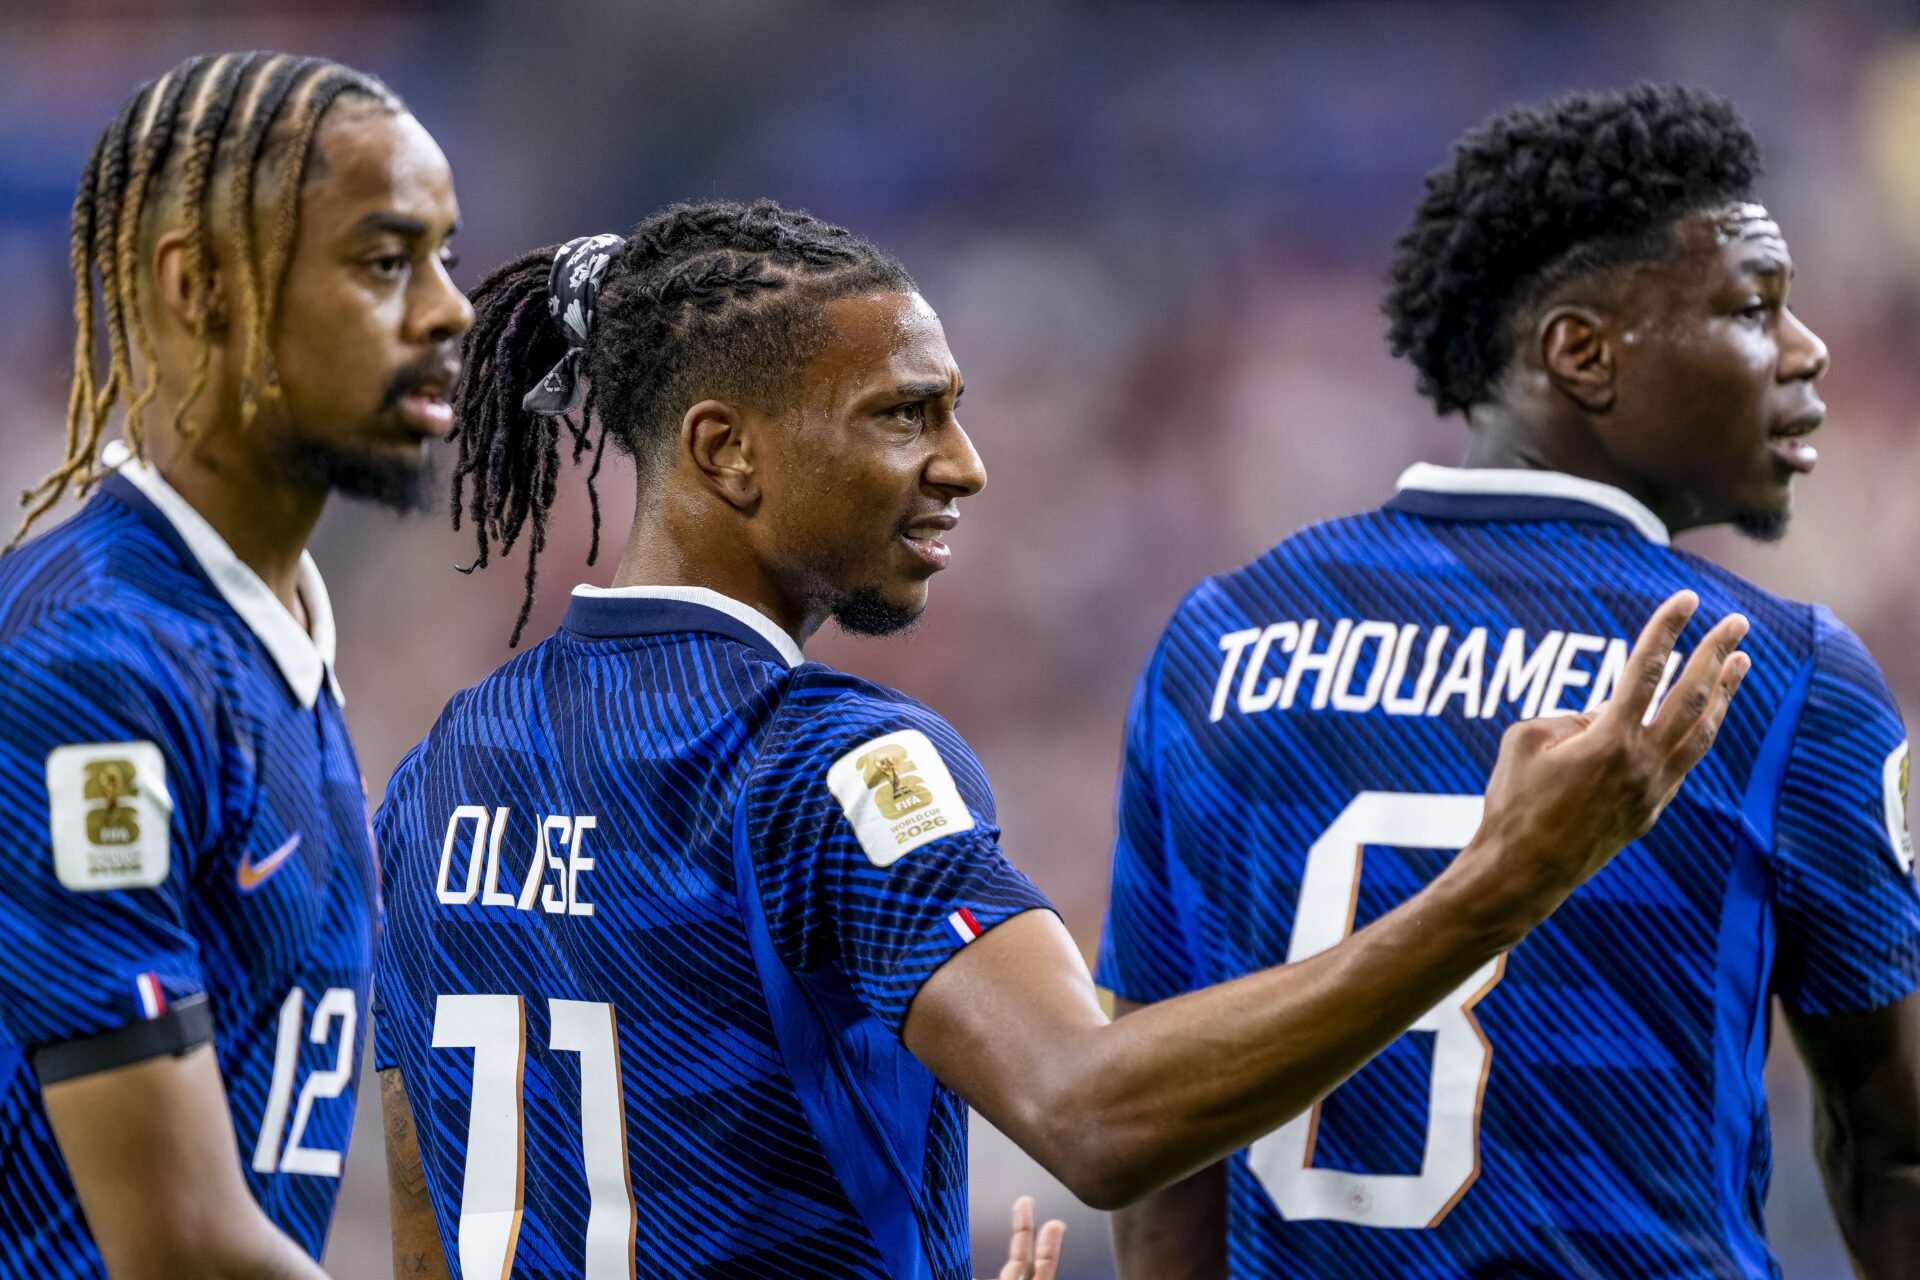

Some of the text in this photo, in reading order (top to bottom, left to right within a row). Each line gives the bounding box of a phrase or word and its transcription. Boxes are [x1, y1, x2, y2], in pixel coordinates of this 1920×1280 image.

[890, 807, 942, 833] WORLD CUP
[894, 795, 922, 812] FIFA
[895, 816, 948, 845] 2026
[436, 805, 598, 916] OLISE
[1247, 790, 1508, 1229] 8
[252, 986, 356, 1177] 12
[431, 994, 637, 1280] 11
